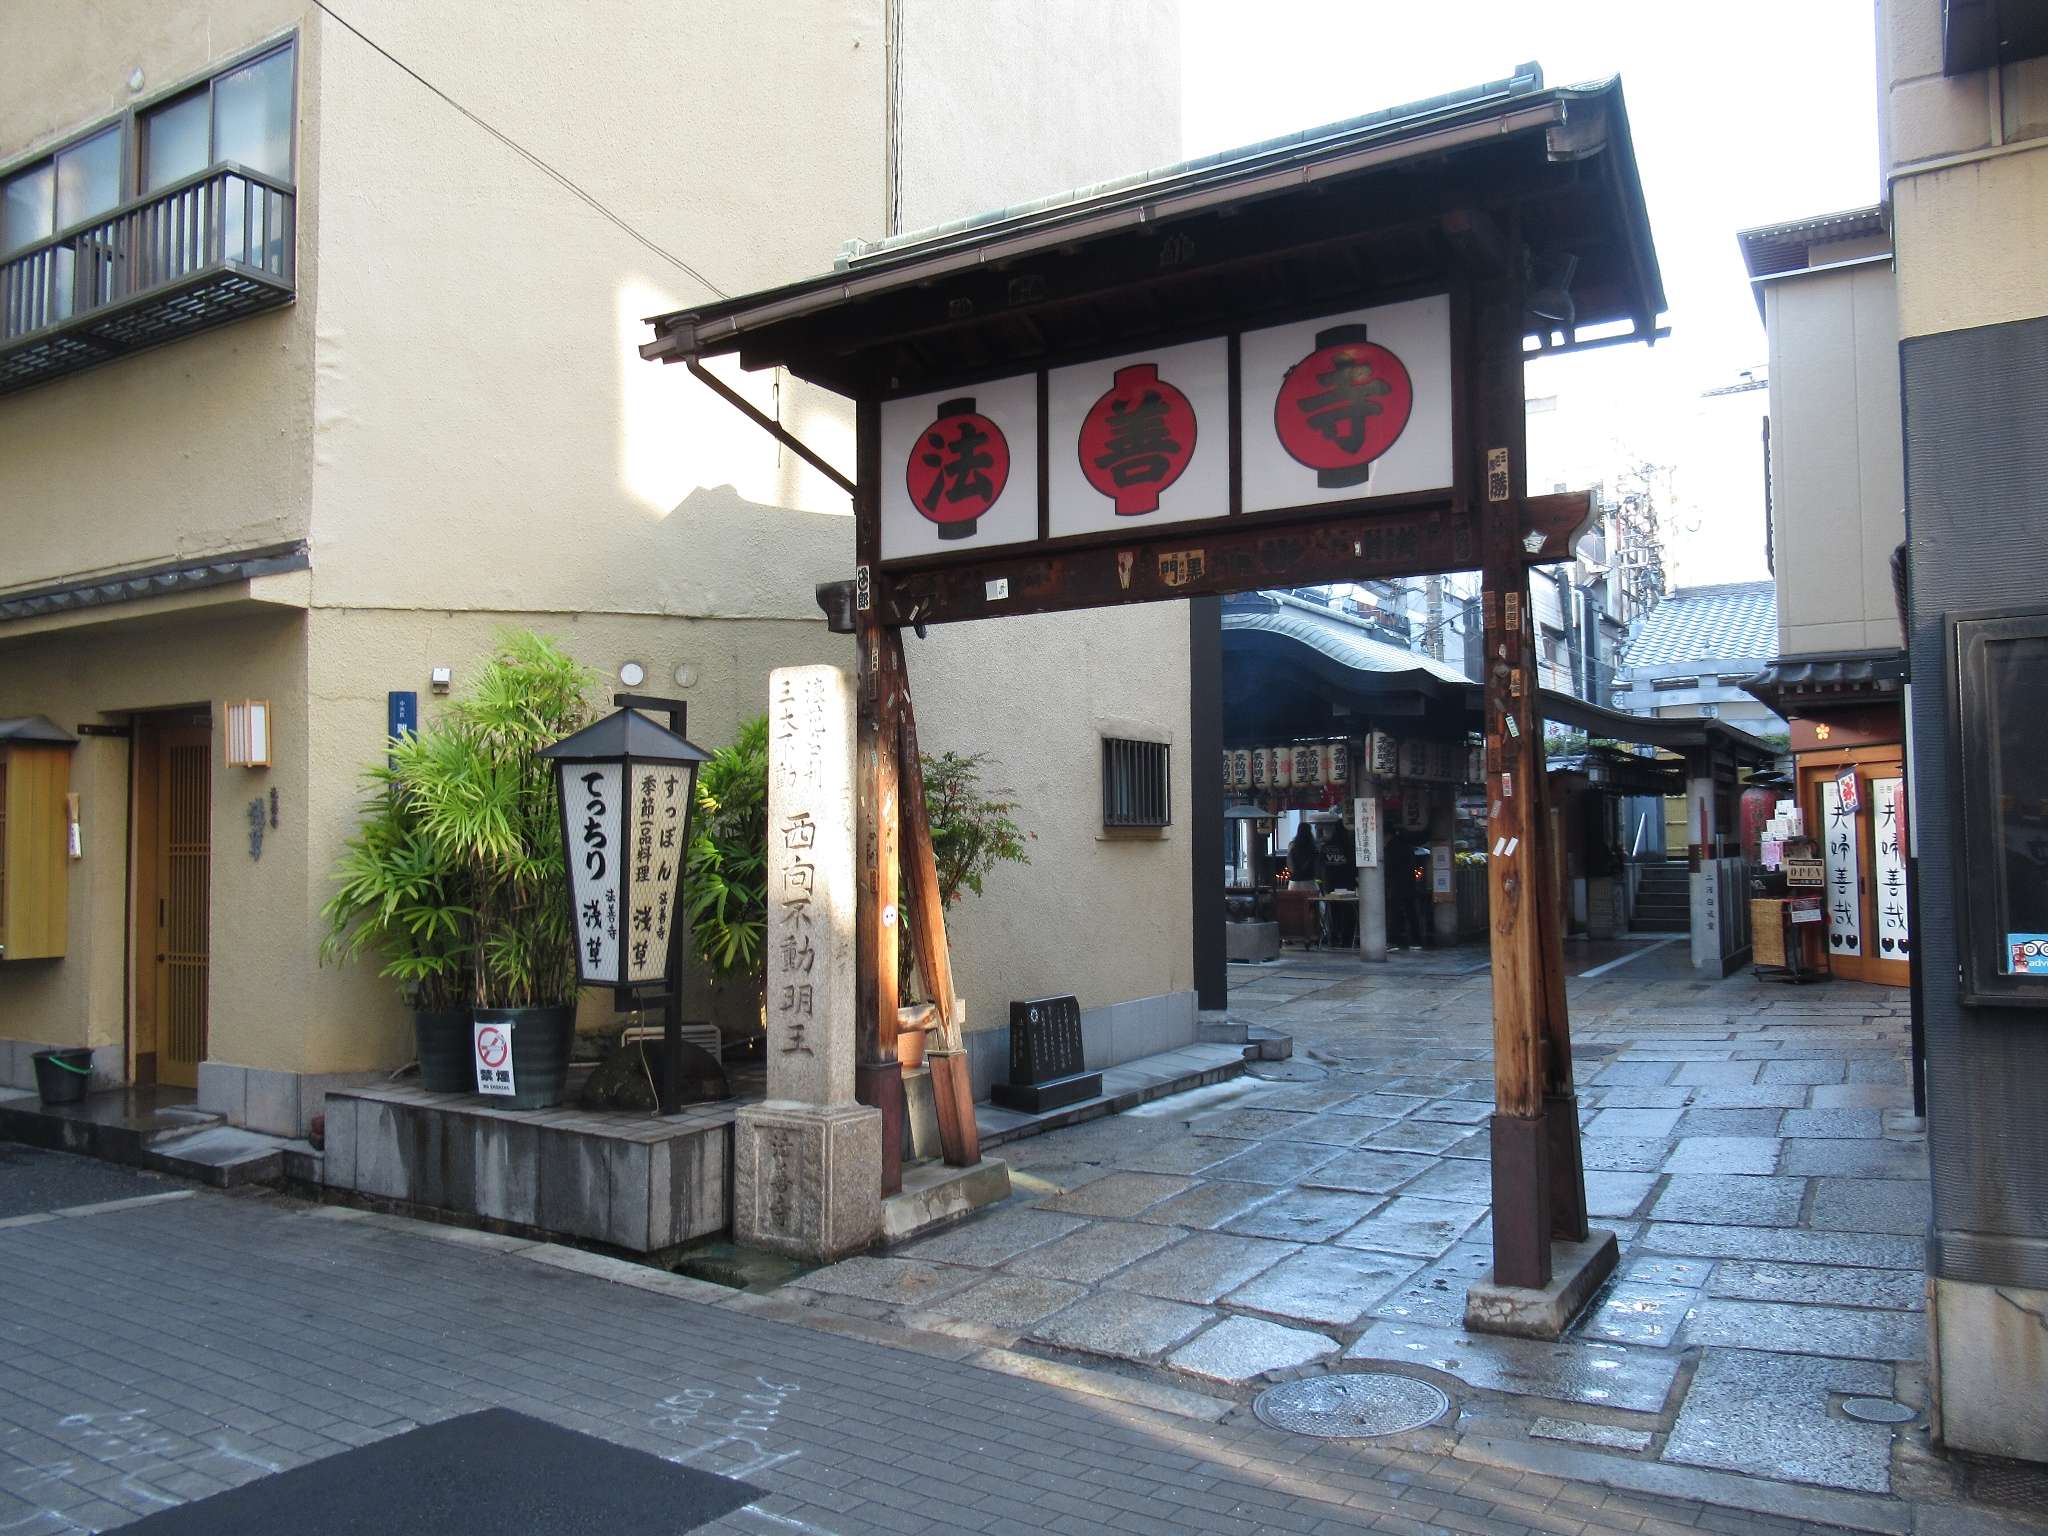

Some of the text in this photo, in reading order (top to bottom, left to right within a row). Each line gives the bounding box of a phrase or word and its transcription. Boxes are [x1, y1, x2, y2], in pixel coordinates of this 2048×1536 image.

[581, 772, 607, 880] てっちり
[635, 775, 657, 883] 季節一品料理
[656, 774, 679, 881] すっぽん
[1790, 867, 1821, 877] OPEN
[1830, 801, 1855, 927] 夫婦善哉
[582, 899, 602, 969] 浅草
[605, 888, 617, 940] 法善寺
[633, 906, 652, 970] 浅草
[656, 892, 668, 940] 法善寺
[779, 812, 815, 1058] 西向不動明王
[480, 1069, 510, 1082] 禁煙
